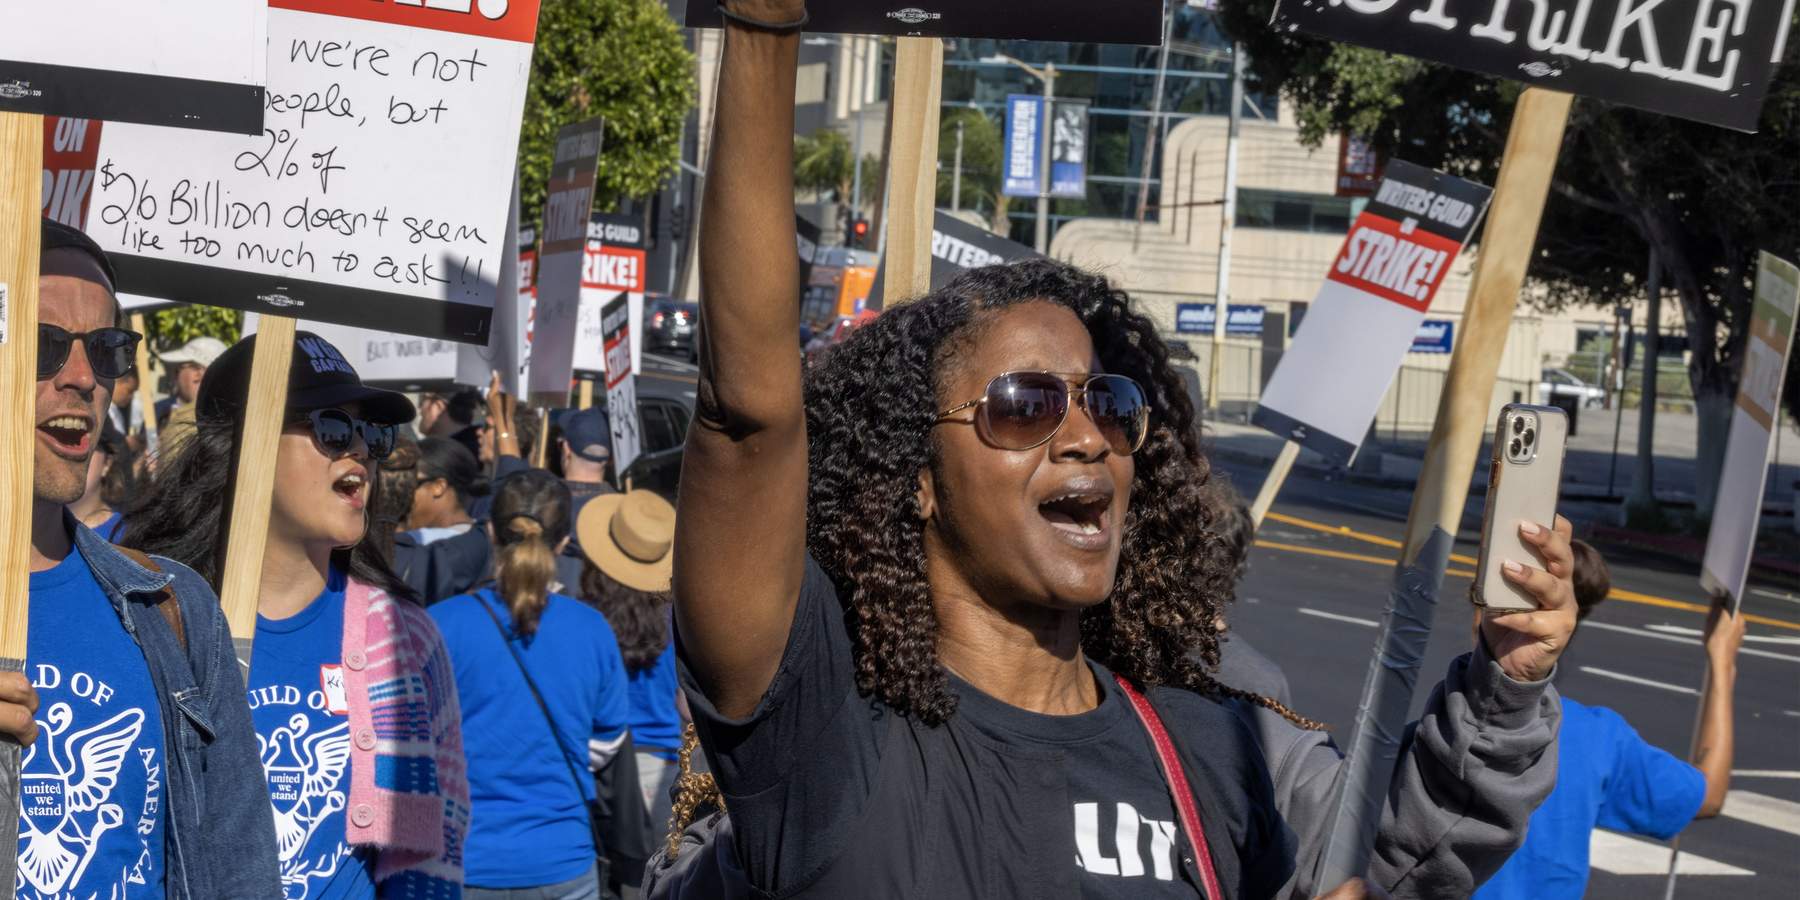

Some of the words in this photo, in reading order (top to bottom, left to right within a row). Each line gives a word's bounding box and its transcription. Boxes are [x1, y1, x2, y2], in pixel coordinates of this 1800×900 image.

[290, 39, 389, 76] we're
[412, 48, 487, 81] not
[1330, 0, 1748, 92] IKE
[265, 83, 366, 128] eople,
[388, 95, 448, 124] but
[53, 117, 88, 152] ON
[234, 128, 299, 180] 2%
[312, 147, 346, 193] of
[168, 180, 270, 229] Billion
[403, 217, 487, 244] seem
[1428, 194, 1475, 229] GUILD
[605, 224, 640, 244] GUILD
[931, 230, 1004, 268] RITER
[121, 220, 164, 252] like
[180, 230, 221, 257] too
[238, 241, 315, 272] much
[332, 250, 359, 272] to
[374, 253, 450, 286] ask
[582, 252, 638, 288] RIKE!
[1337, 227, 1448, 301] STRIKE!
[71, 672, 114, 706] OF
[247, 685, 301, 709] UILD
[24, 783, 61, 796] united
[270, 772, 300, 784] united
[271, 789, 297, 801] stand
[277, 784, 292, 792] we
[28, 804, 62, 816] stand
[35, 795, 54, 805] we
